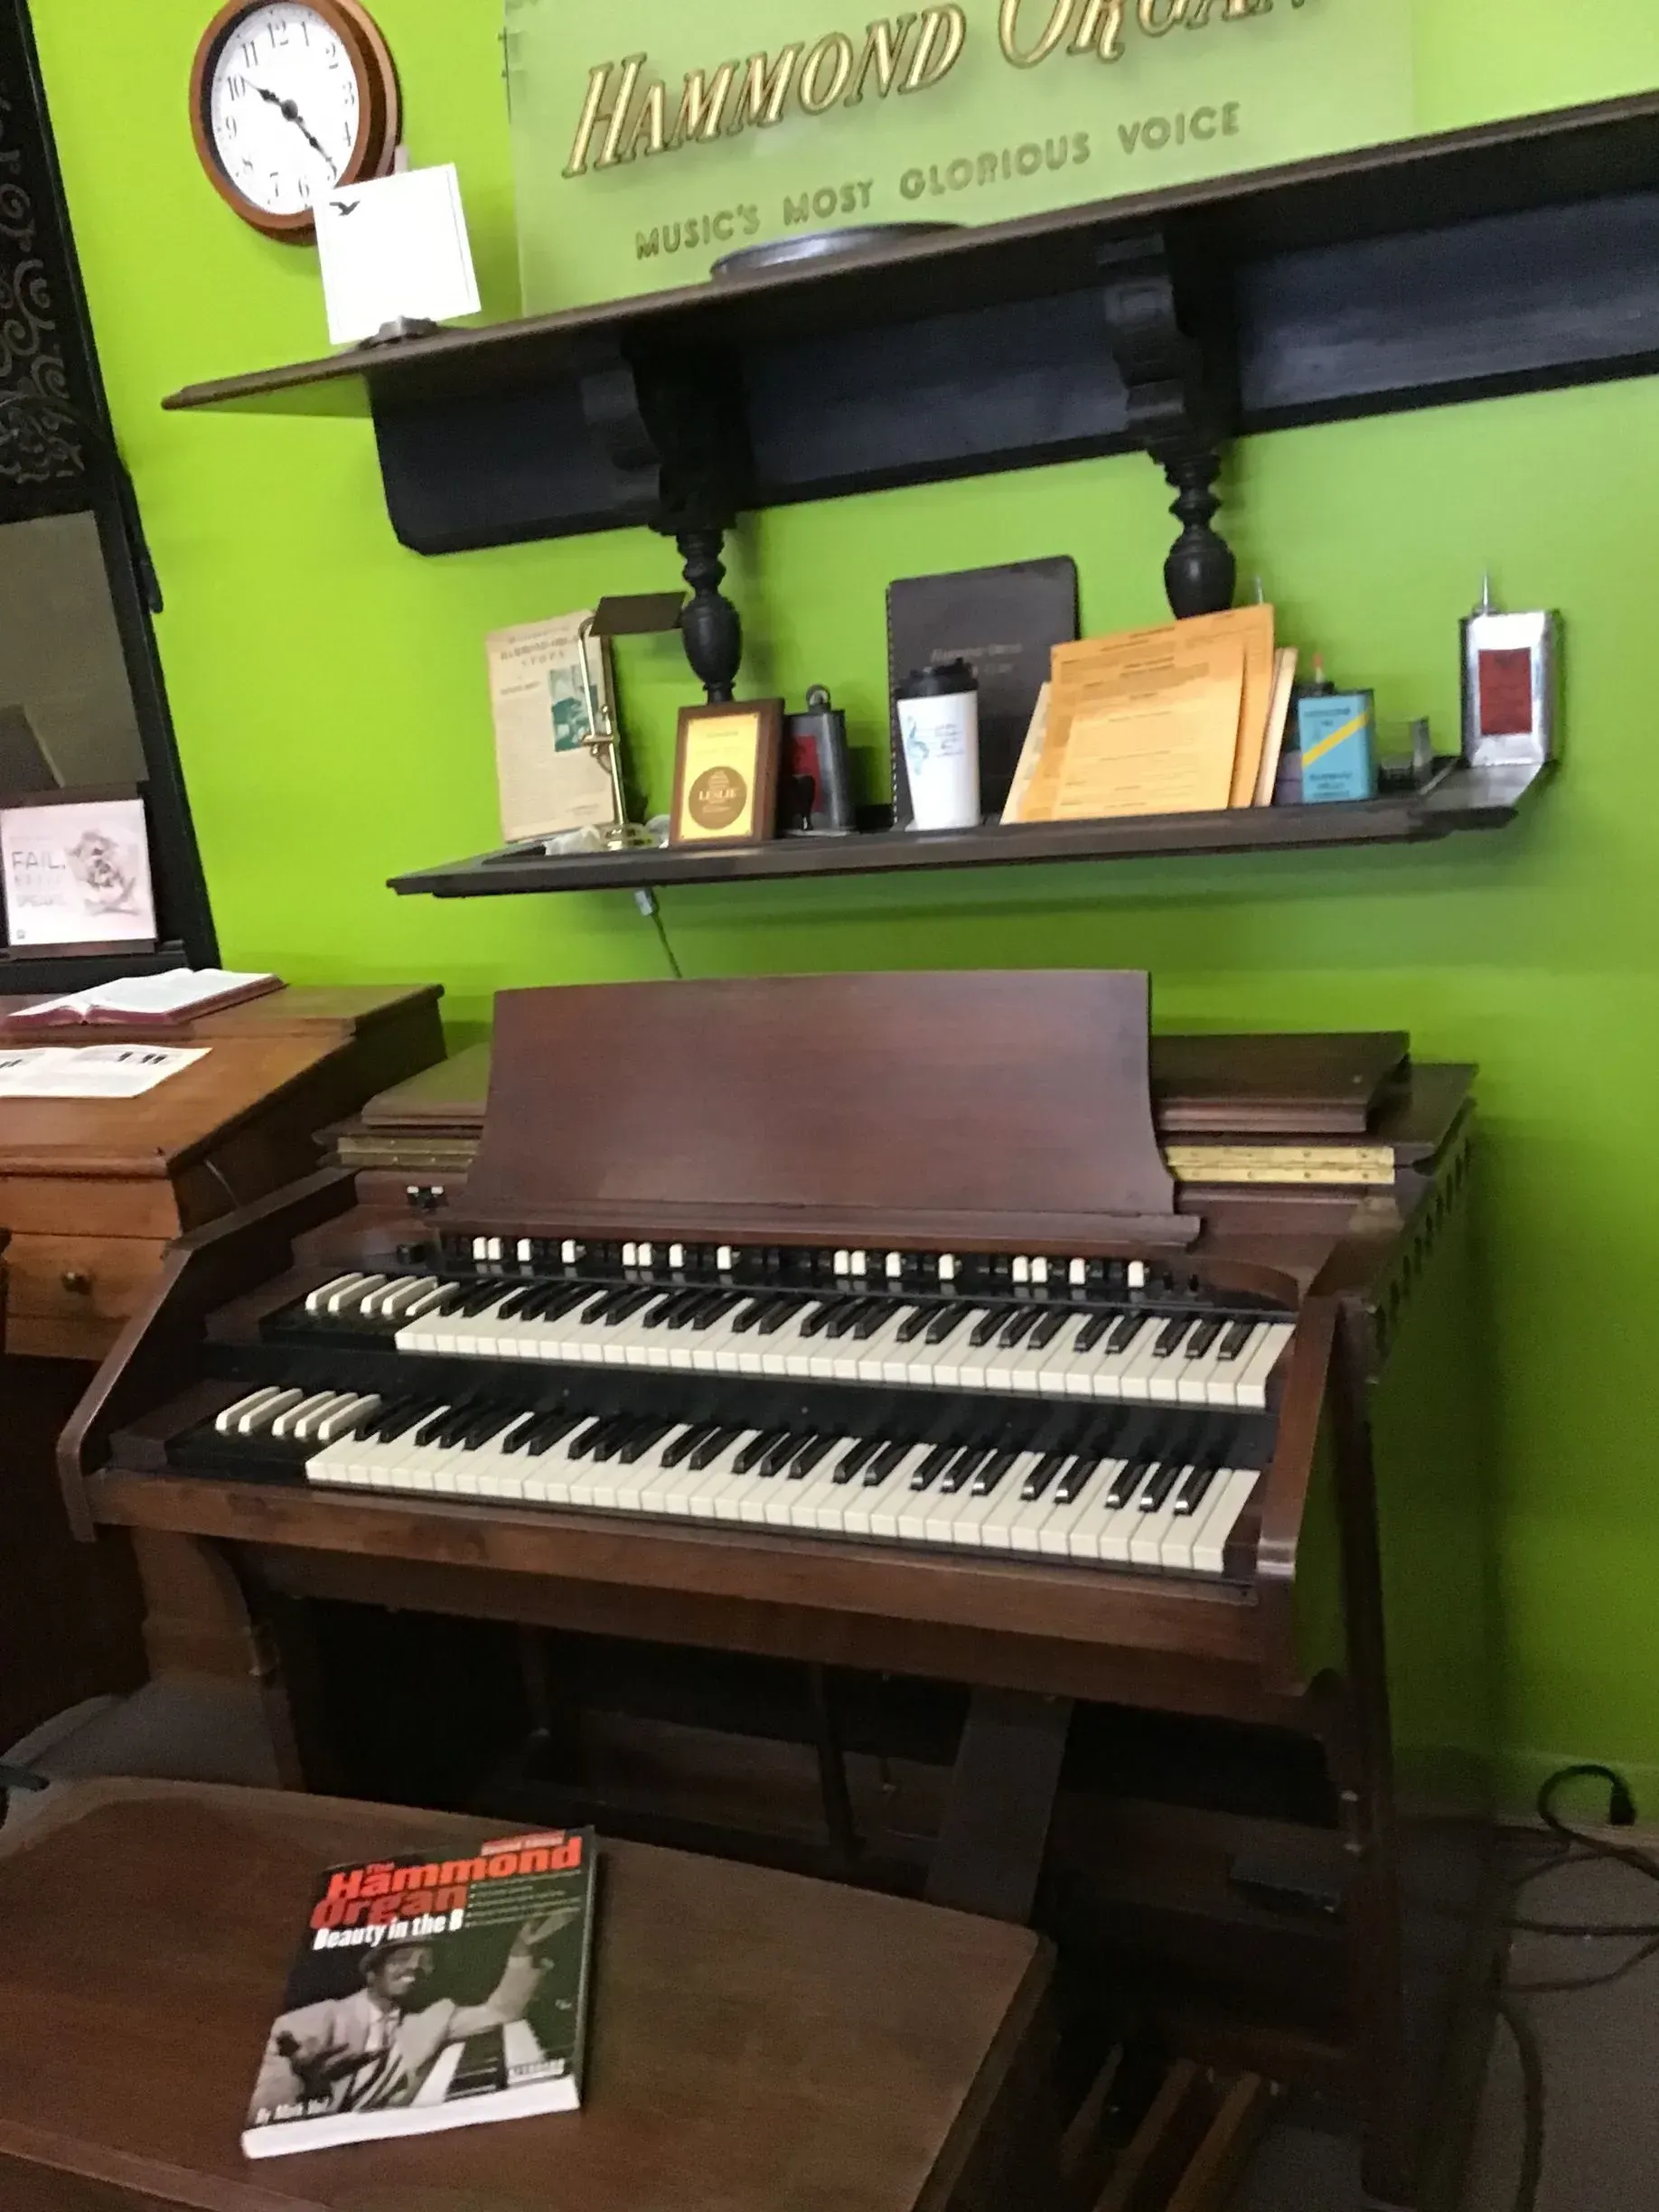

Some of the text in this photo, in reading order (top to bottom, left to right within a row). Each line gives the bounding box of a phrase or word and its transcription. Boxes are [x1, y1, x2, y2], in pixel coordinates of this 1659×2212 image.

[267, 20, 289, 48] 12
[301, 21, 309, 46] 1
[242, 40, 258, 68] 11
[325, 42, 339, 70] 2
[228, 75, 246, 101] 10
[562, 3, 967, 178] HAMMOND
[269, 171, 279, 198] 7
[635, 101, 1241, 260] MUSIC'S MOST GLORIOUS VOICE
[327, 1836, 583, 1899] Hammond
[313, 1924, 385, 1951] Beauty
[386, 1916, 409, 1941] in
[411, 1912, 447, 1936] the
